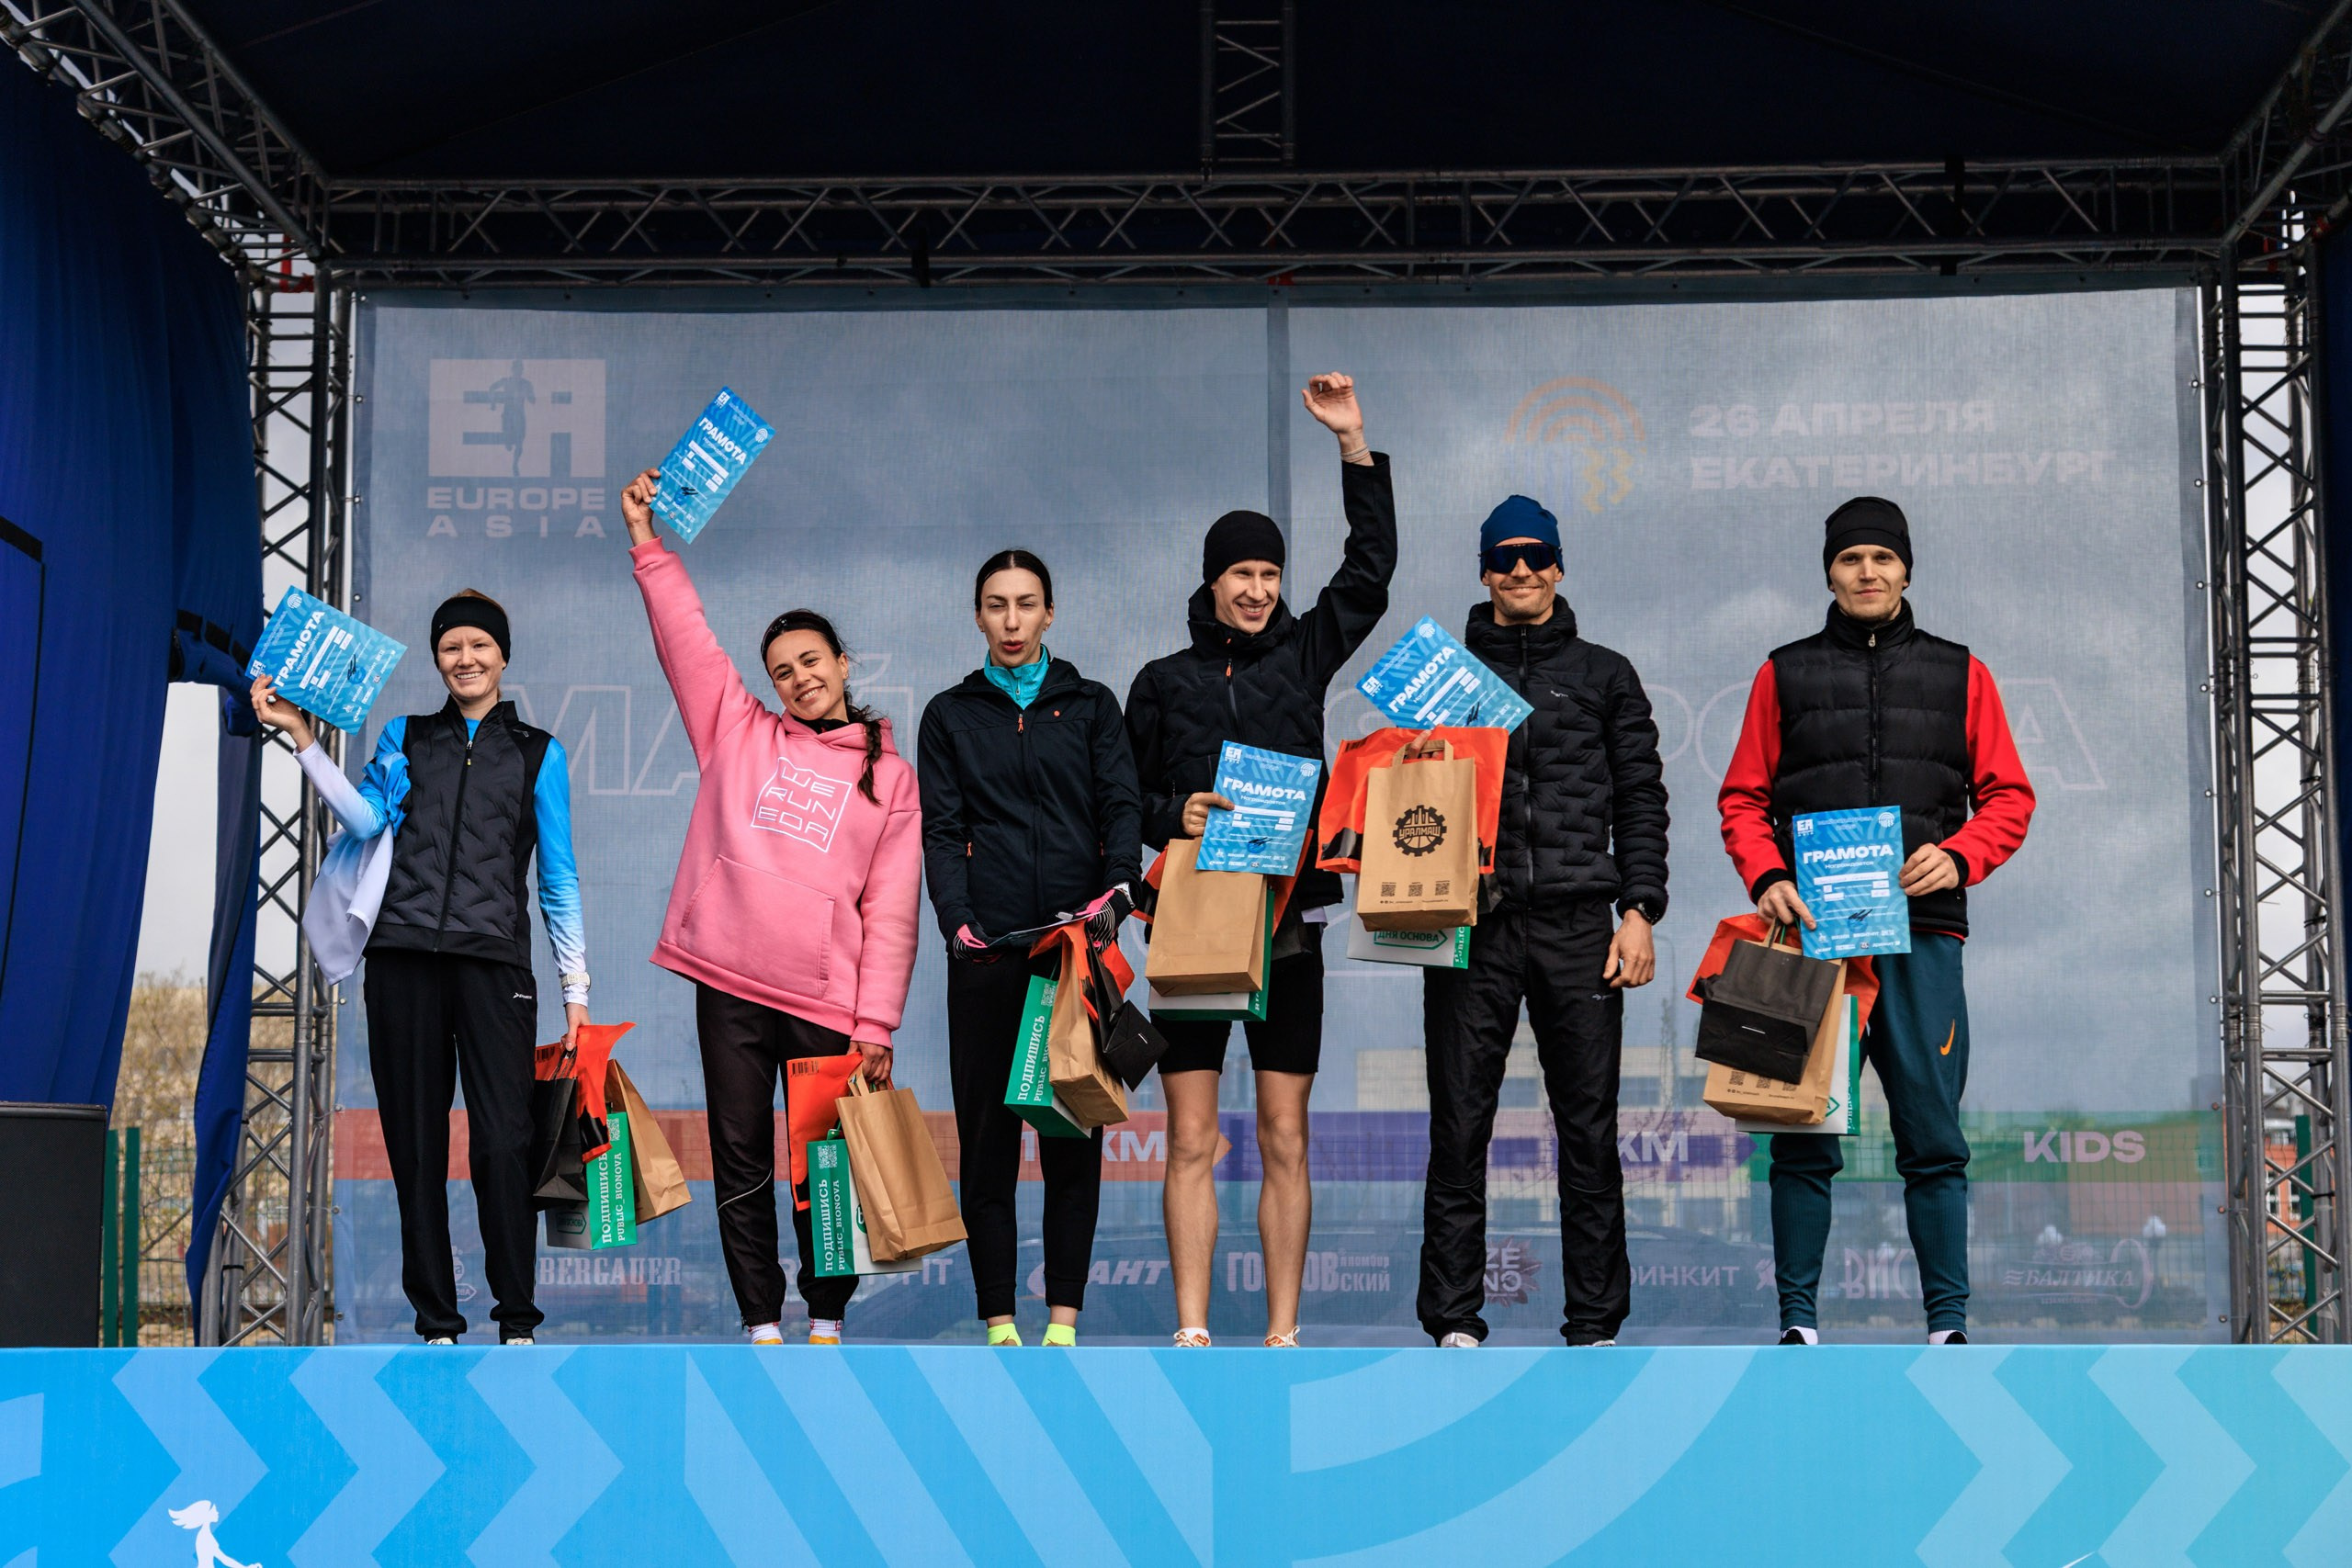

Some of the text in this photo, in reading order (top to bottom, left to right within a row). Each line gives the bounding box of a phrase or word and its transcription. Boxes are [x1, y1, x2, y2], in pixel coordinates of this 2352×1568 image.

[1689, 400, 1997, 437] 26 АПРЕЛЯ
[698, 417, 748, 465] ГРАМОТА
[1689, 449, 2116, 490] ЕКАТЕРИНБУРГ
[427, 487, 605, 510] EUROPE
[426, 514, 606, 537] ASIA
[275, 611, 325, 687] ГРАМОТА
[1387, 646, 1456, 713] ГРАМОТА
[782, 766, 835, 797] WE
[1223, 777, 1306, 801] ГРАМОТА
[765, 787, 836, 820] RUN
[1398, 825, 1441, 840] УРАЛМАШ
[1803, 844, 1894, 864] ГРАМОТА
[1399, 931, 1440, 942] ОСНОВА
[1017, 1015, 1046, 1101] ПОДПИШИСЬ
[2023, 1131, 2146, 1163] KIDS
[598, 1152, 613, 1244] ПОДПИШИСЬ
[614, 1153, 626, 1242] PUBLIC_BIONOVA
[819, 1179, 832, 1271] ПОДПИШИСЬ
[832, 1179, 845, 1270] PUBLIC_BIONOVA
[538, 1257, 683, 1286] BERGAUER
[1087, 1260, 1170, 1285] АНТ
[2025, 1269, 2134, 1287] БАЛТИКА
